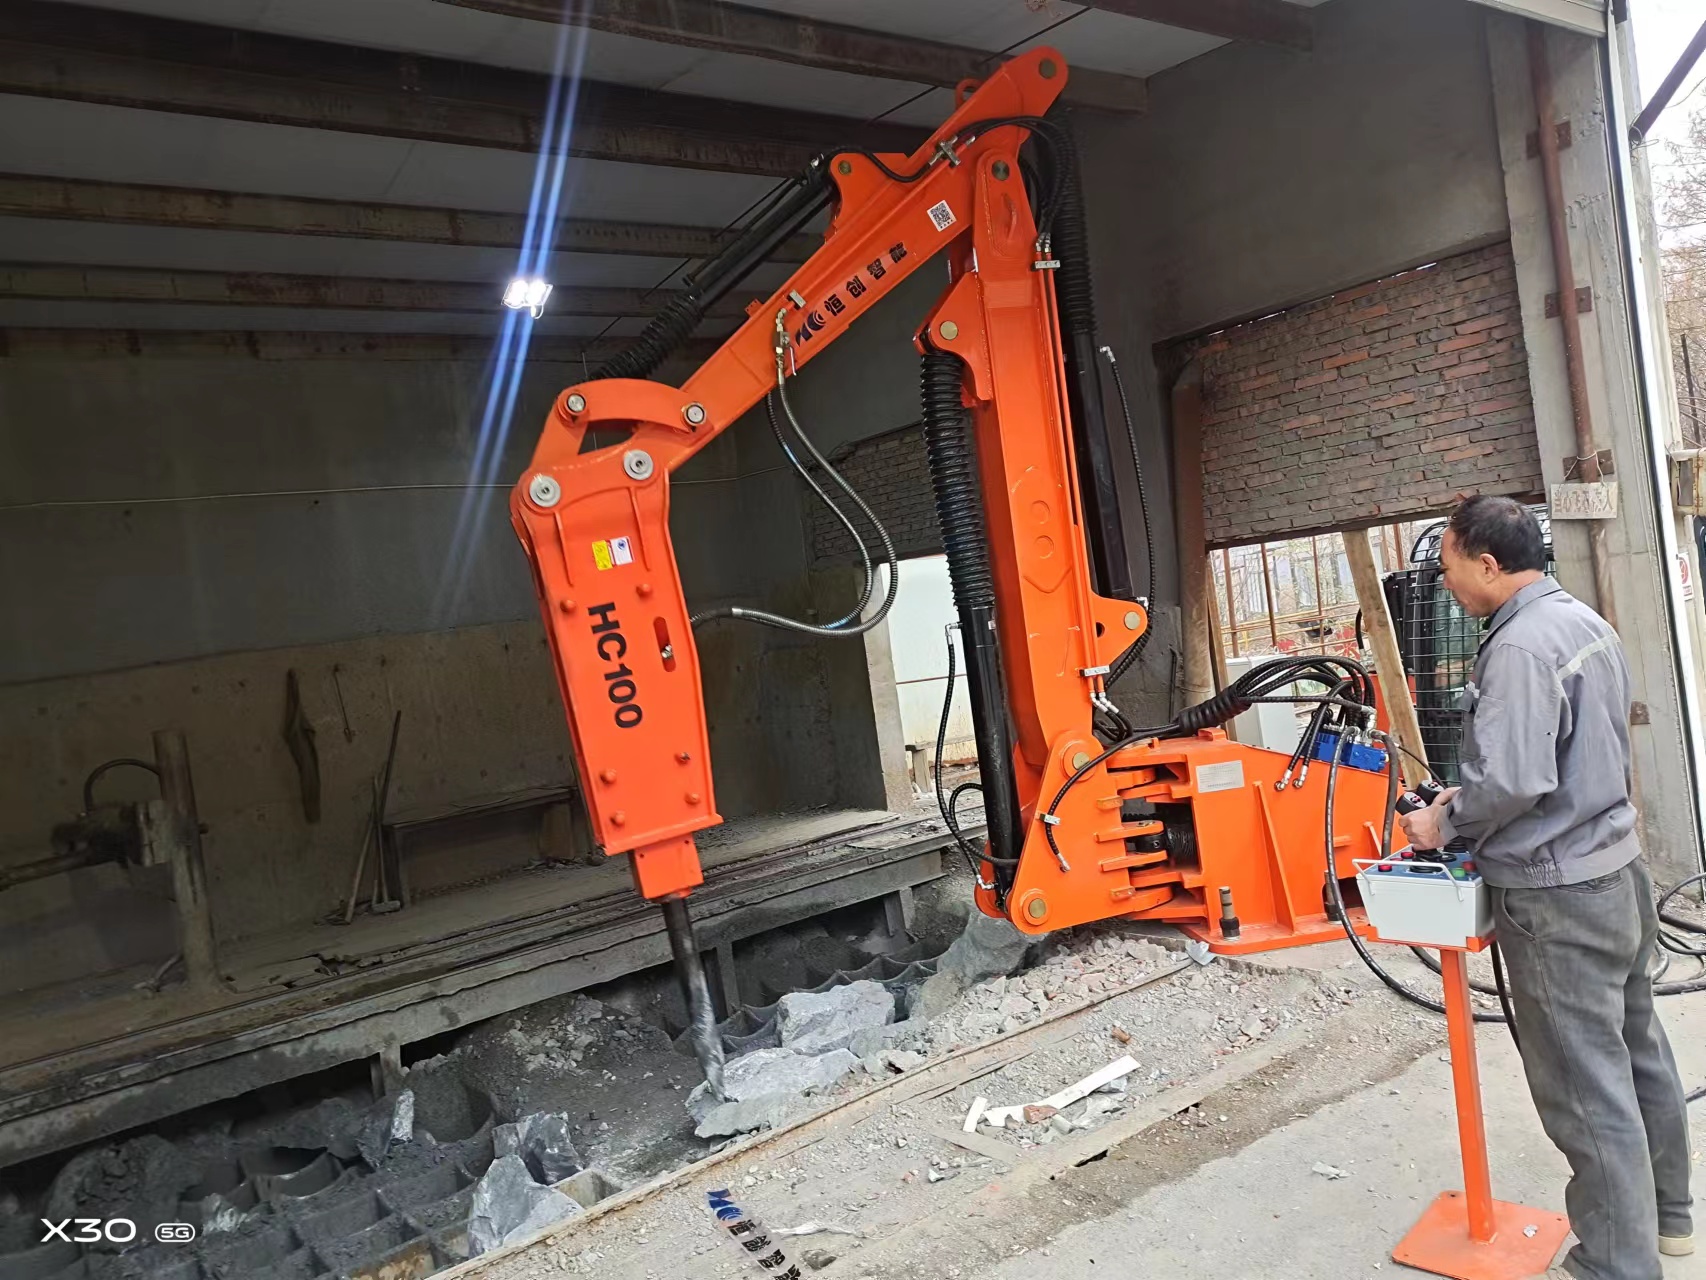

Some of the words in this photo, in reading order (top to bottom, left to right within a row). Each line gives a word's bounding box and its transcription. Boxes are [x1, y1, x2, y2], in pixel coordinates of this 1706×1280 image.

[823, 241, 908, 317] 恒创智能
[587, 601, 643, 729] HC100
